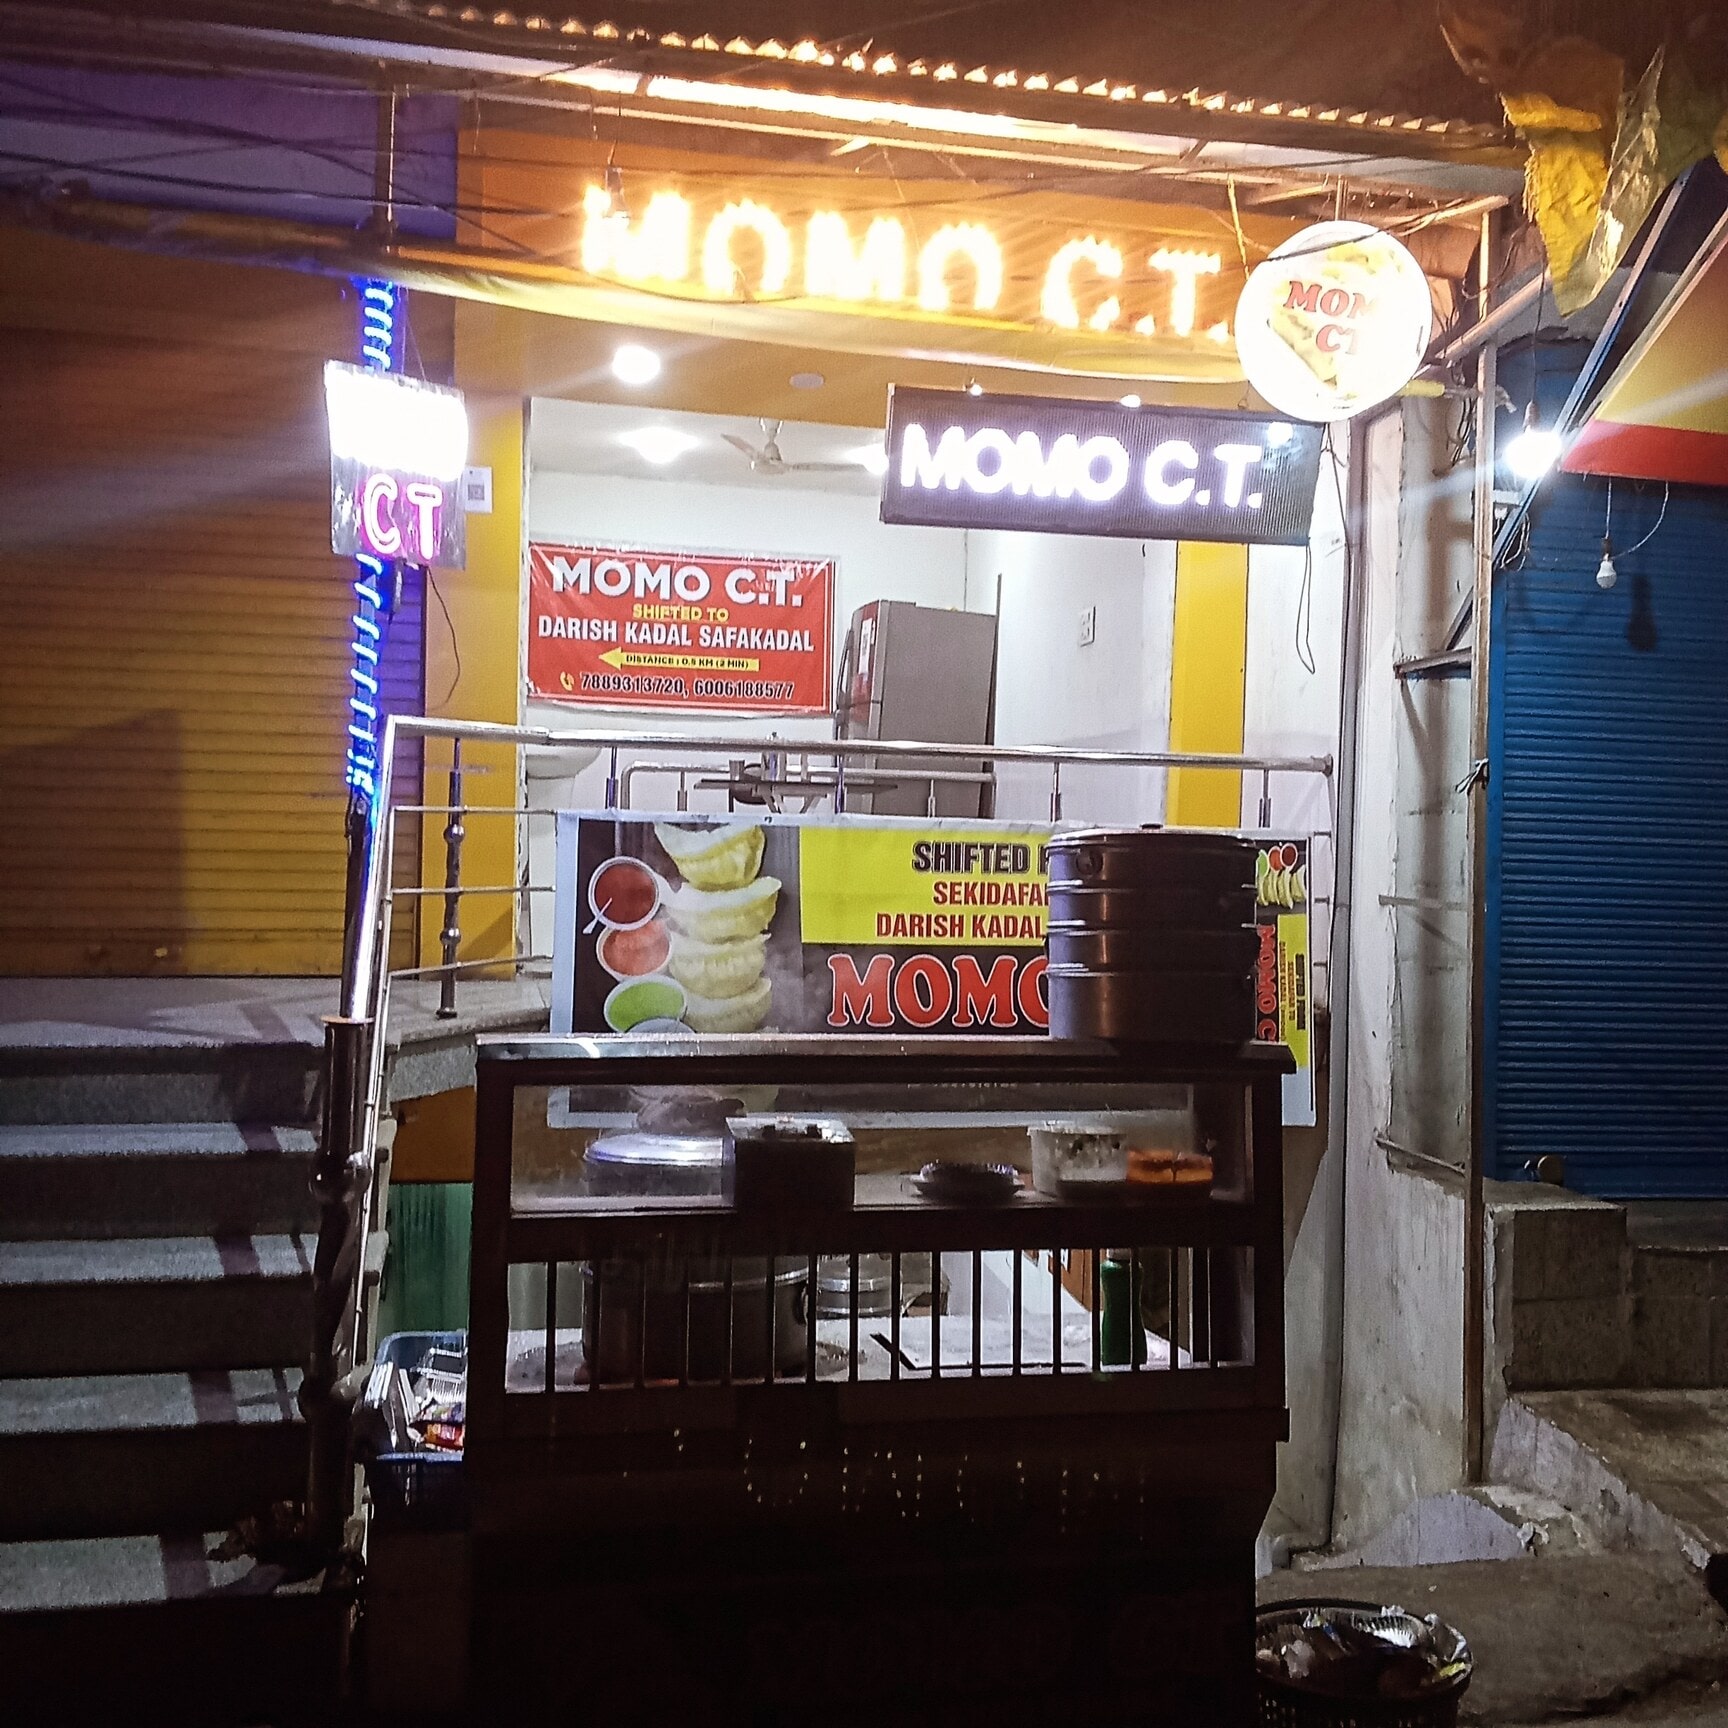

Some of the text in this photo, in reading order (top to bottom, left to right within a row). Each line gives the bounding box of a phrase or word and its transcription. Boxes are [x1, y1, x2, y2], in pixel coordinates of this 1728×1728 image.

[581, 182, 1230, 343] MOMO C.T.
[1283, 280, 1376, 319] MOM
[900, 421, 1264, 509] MOMO C.T.
[363, 472, 443, 560] CT
[551, 555, 803, 608] MOMO C.T.
[632, 602, 729, 623] SHIFTED TO
[538, 615, 815, 652] DARISH KADAL SAFAKADAL
[626, 654, 674, 665] DISTANCE
[698, 658, 714, 667] KM
[727, 660, 749, 669] MIN)
[580, 672, 794, 699] 7889313720, 6006188577
[912, 840, 1032, 875] SHIFTED
[876, 912, 1045, 939] DARISH KADAL
[1257, 924, 1277, 1014] MOMO
